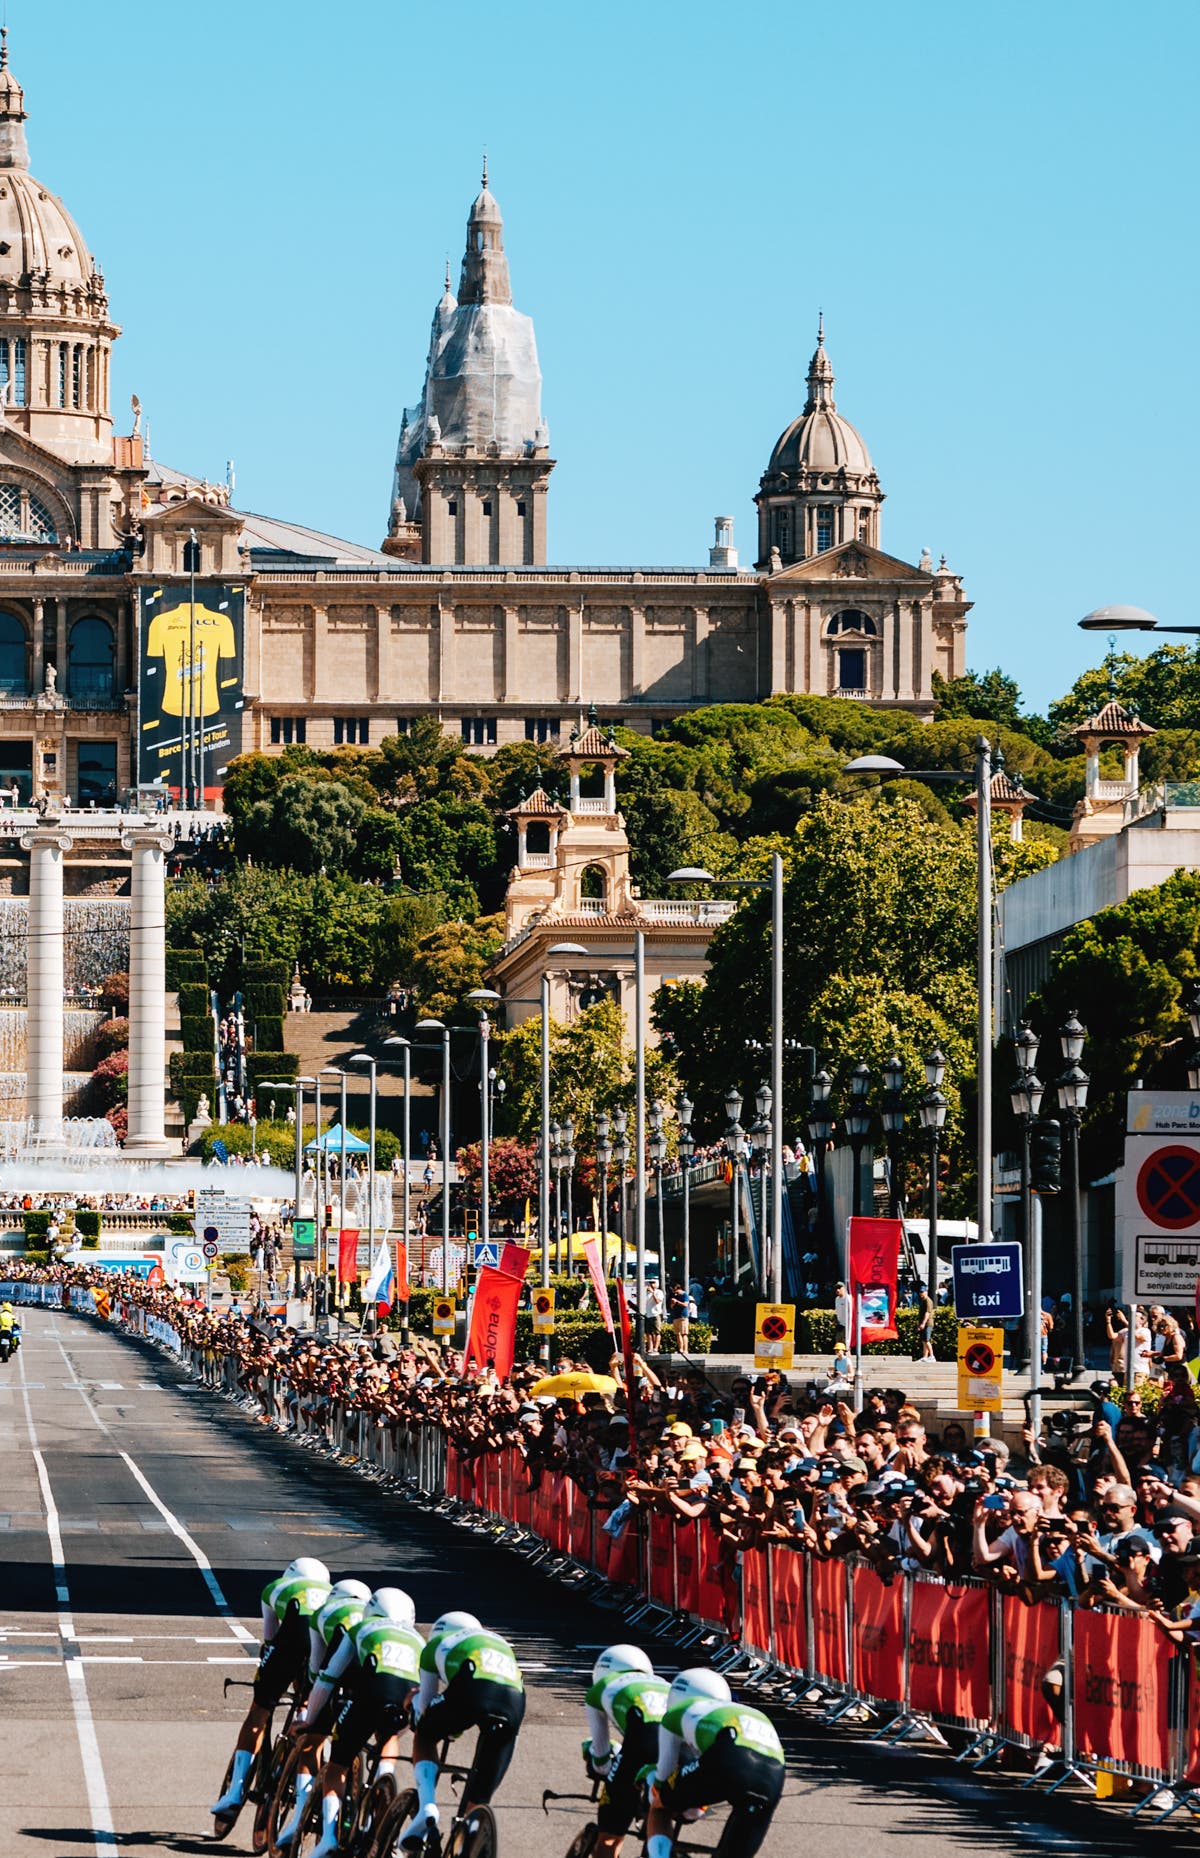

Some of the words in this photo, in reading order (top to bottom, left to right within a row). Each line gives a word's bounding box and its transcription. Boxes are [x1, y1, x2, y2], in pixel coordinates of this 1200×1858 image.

[196, 618, 220, 627] LCL
[158, 739, 200, 758] Barceoa
[212, 729, 228, 741] Tour
[1152, 1101, 1200, 1119] zonab
[1155, 1121, 1171, 1129] Hub
[1171, 1121, 1188, 1129] Parc
[297, 1224, 307, 1239] P
[1139, 1269, 1171, 1279] Excepte
[1147, 1282, 1197, 1291] senyalitzade
[972, 1291, 1001, 1307] taxi
[484, 1312, 500, 1360] elona
